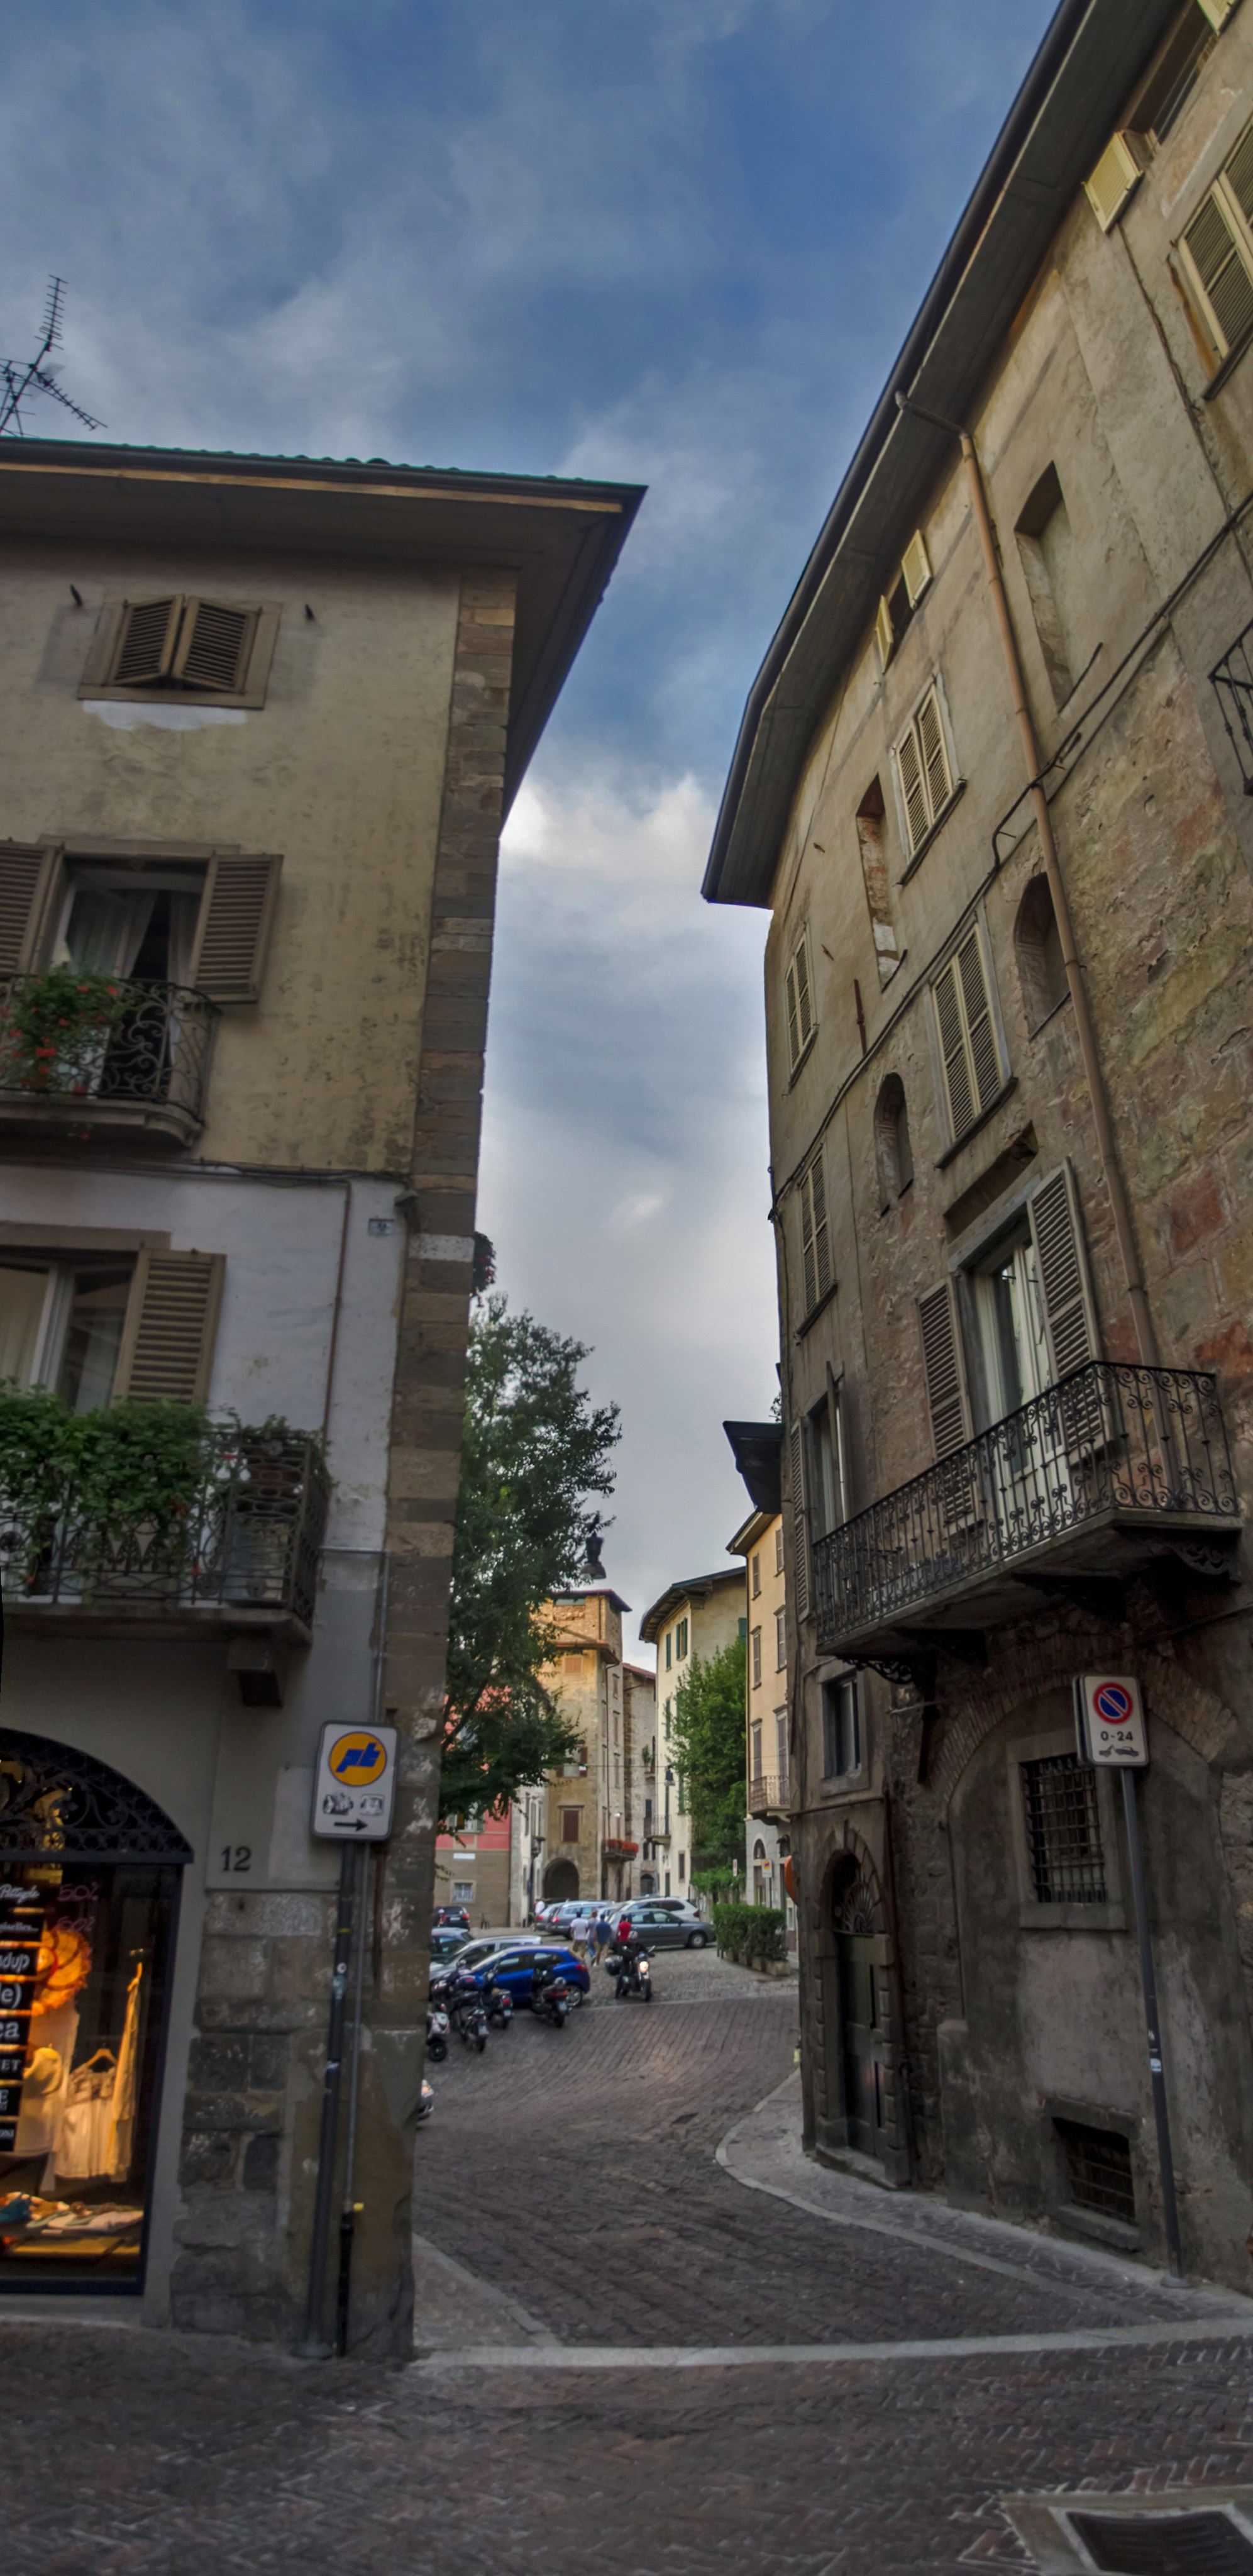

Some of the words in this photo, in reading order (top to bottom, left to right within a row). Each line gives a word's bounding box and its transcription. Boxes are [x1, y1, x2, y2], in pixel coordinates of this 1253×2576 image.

[1101, 1730, 1134, 1741] 0-24
[221, 1845, 252, 1872] 12
[57, 1881, 99, 1902] 50%
